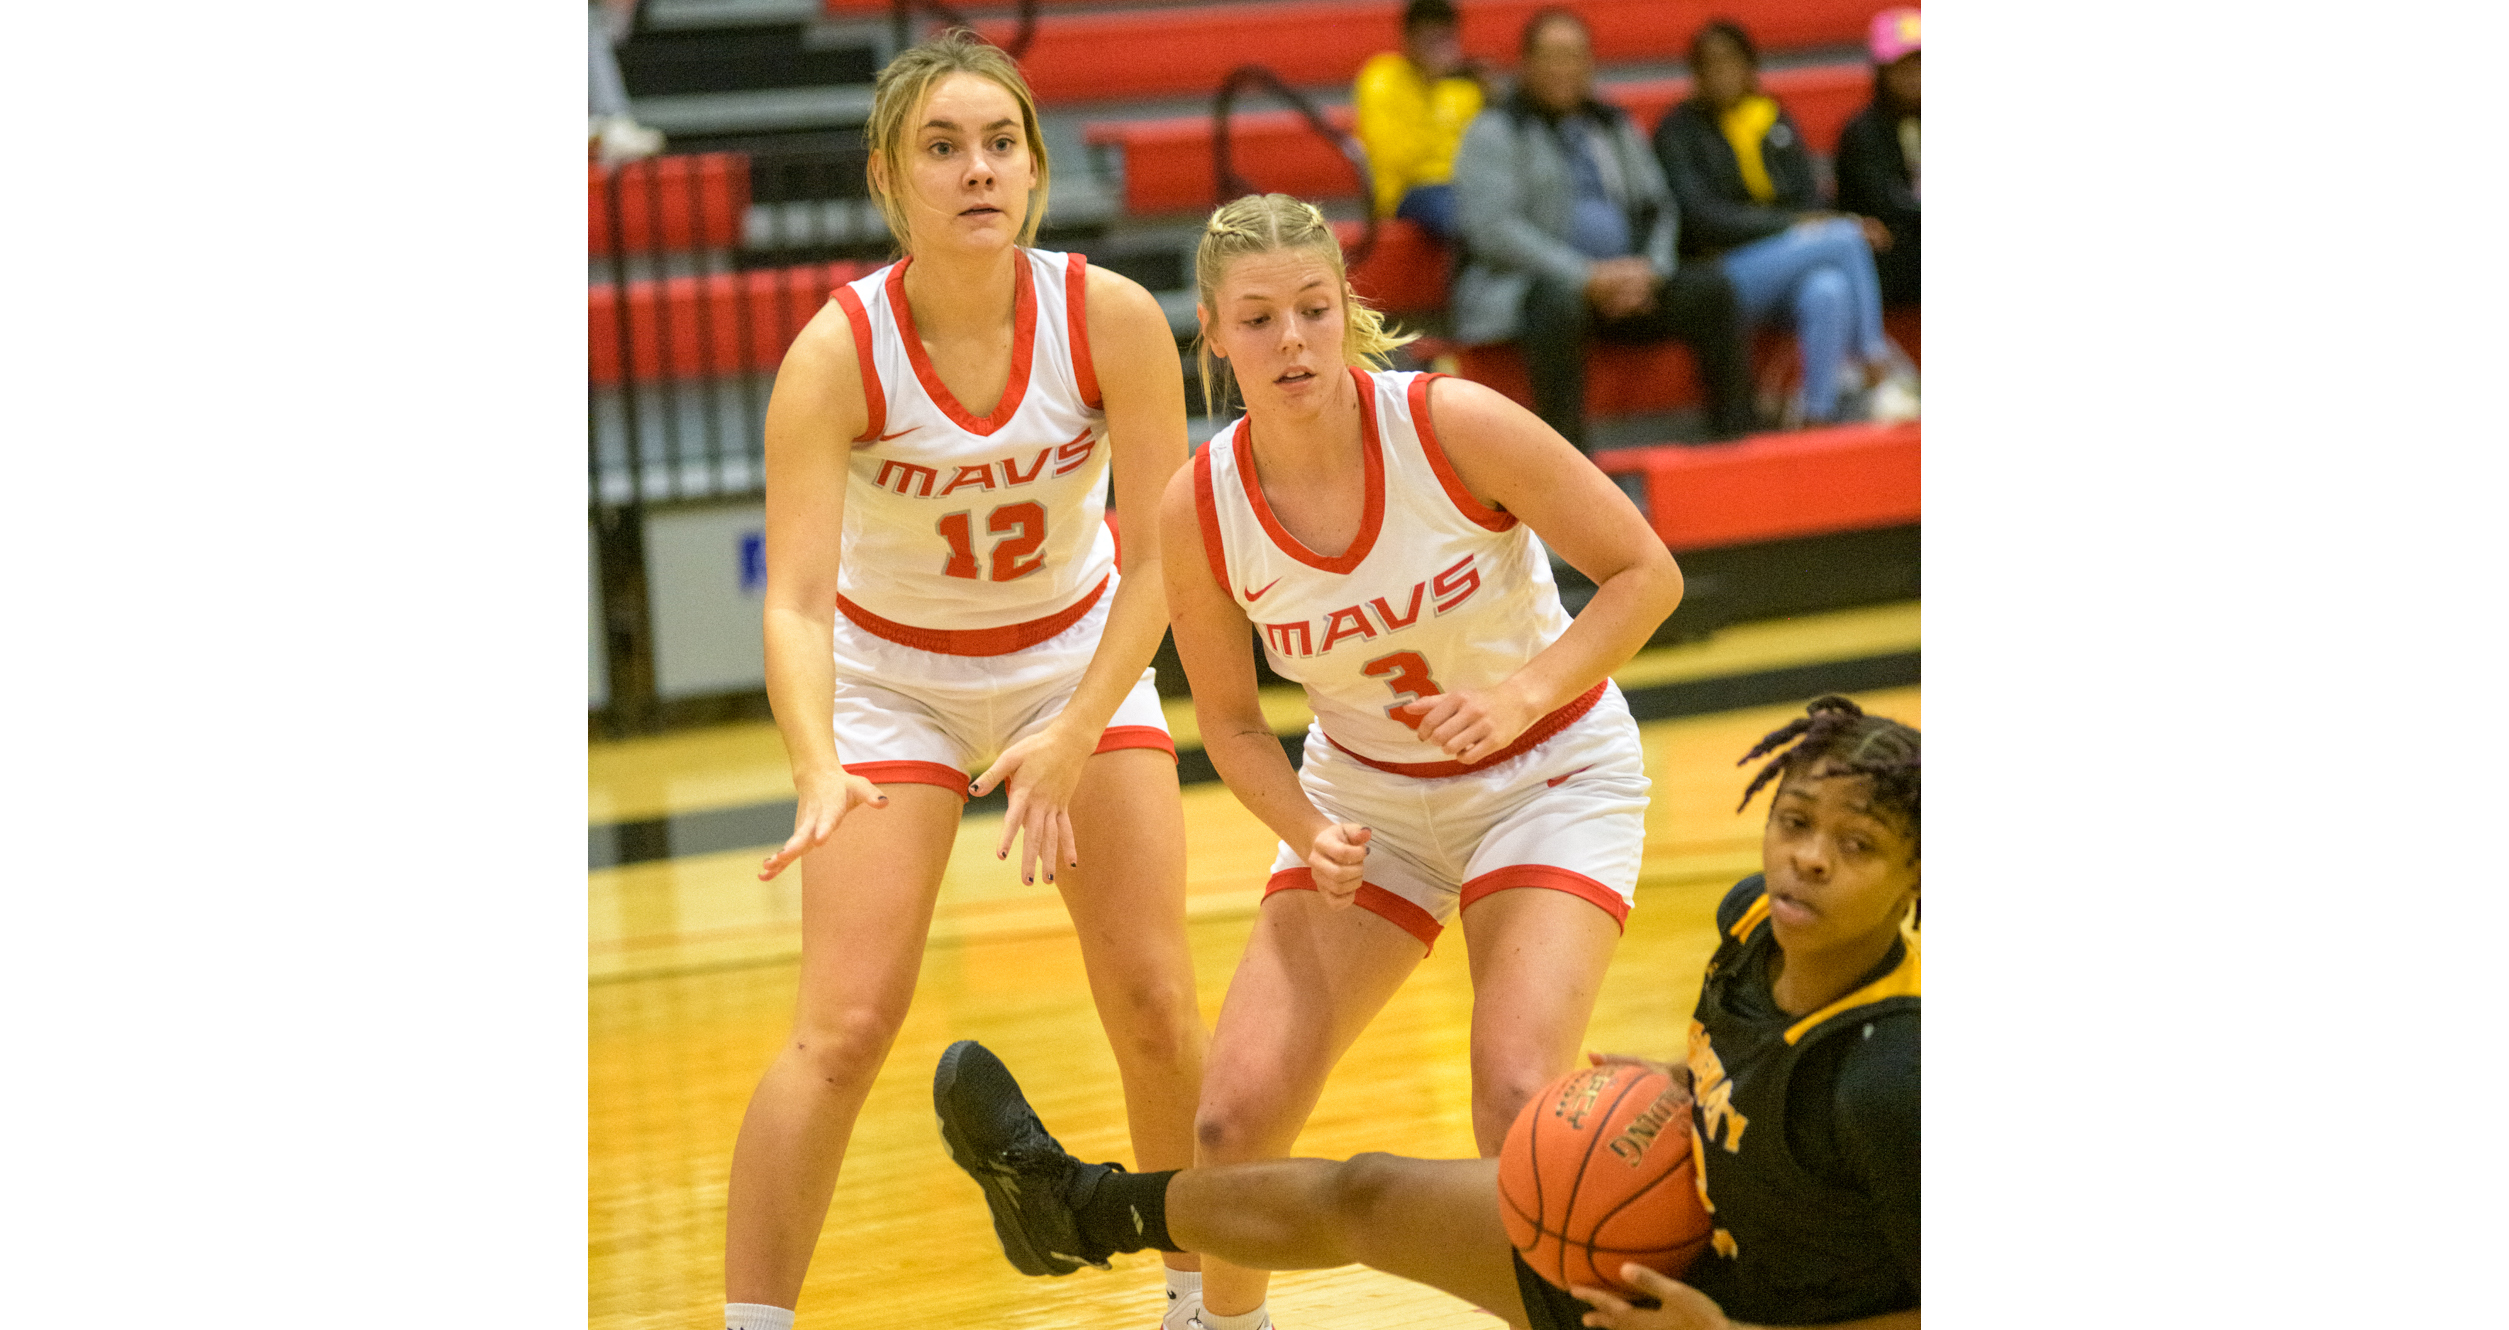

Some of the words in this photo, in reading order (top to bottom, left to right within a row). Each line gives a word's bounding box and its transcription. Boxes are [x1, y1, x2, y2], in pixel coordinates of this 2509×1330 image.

[871, 427, 1097, 499] MAVS
[935, 498, 1048, 583] 12
[1265, 552, 1481, 660] MAVS
[1359, 649, 1446, 732] 3
